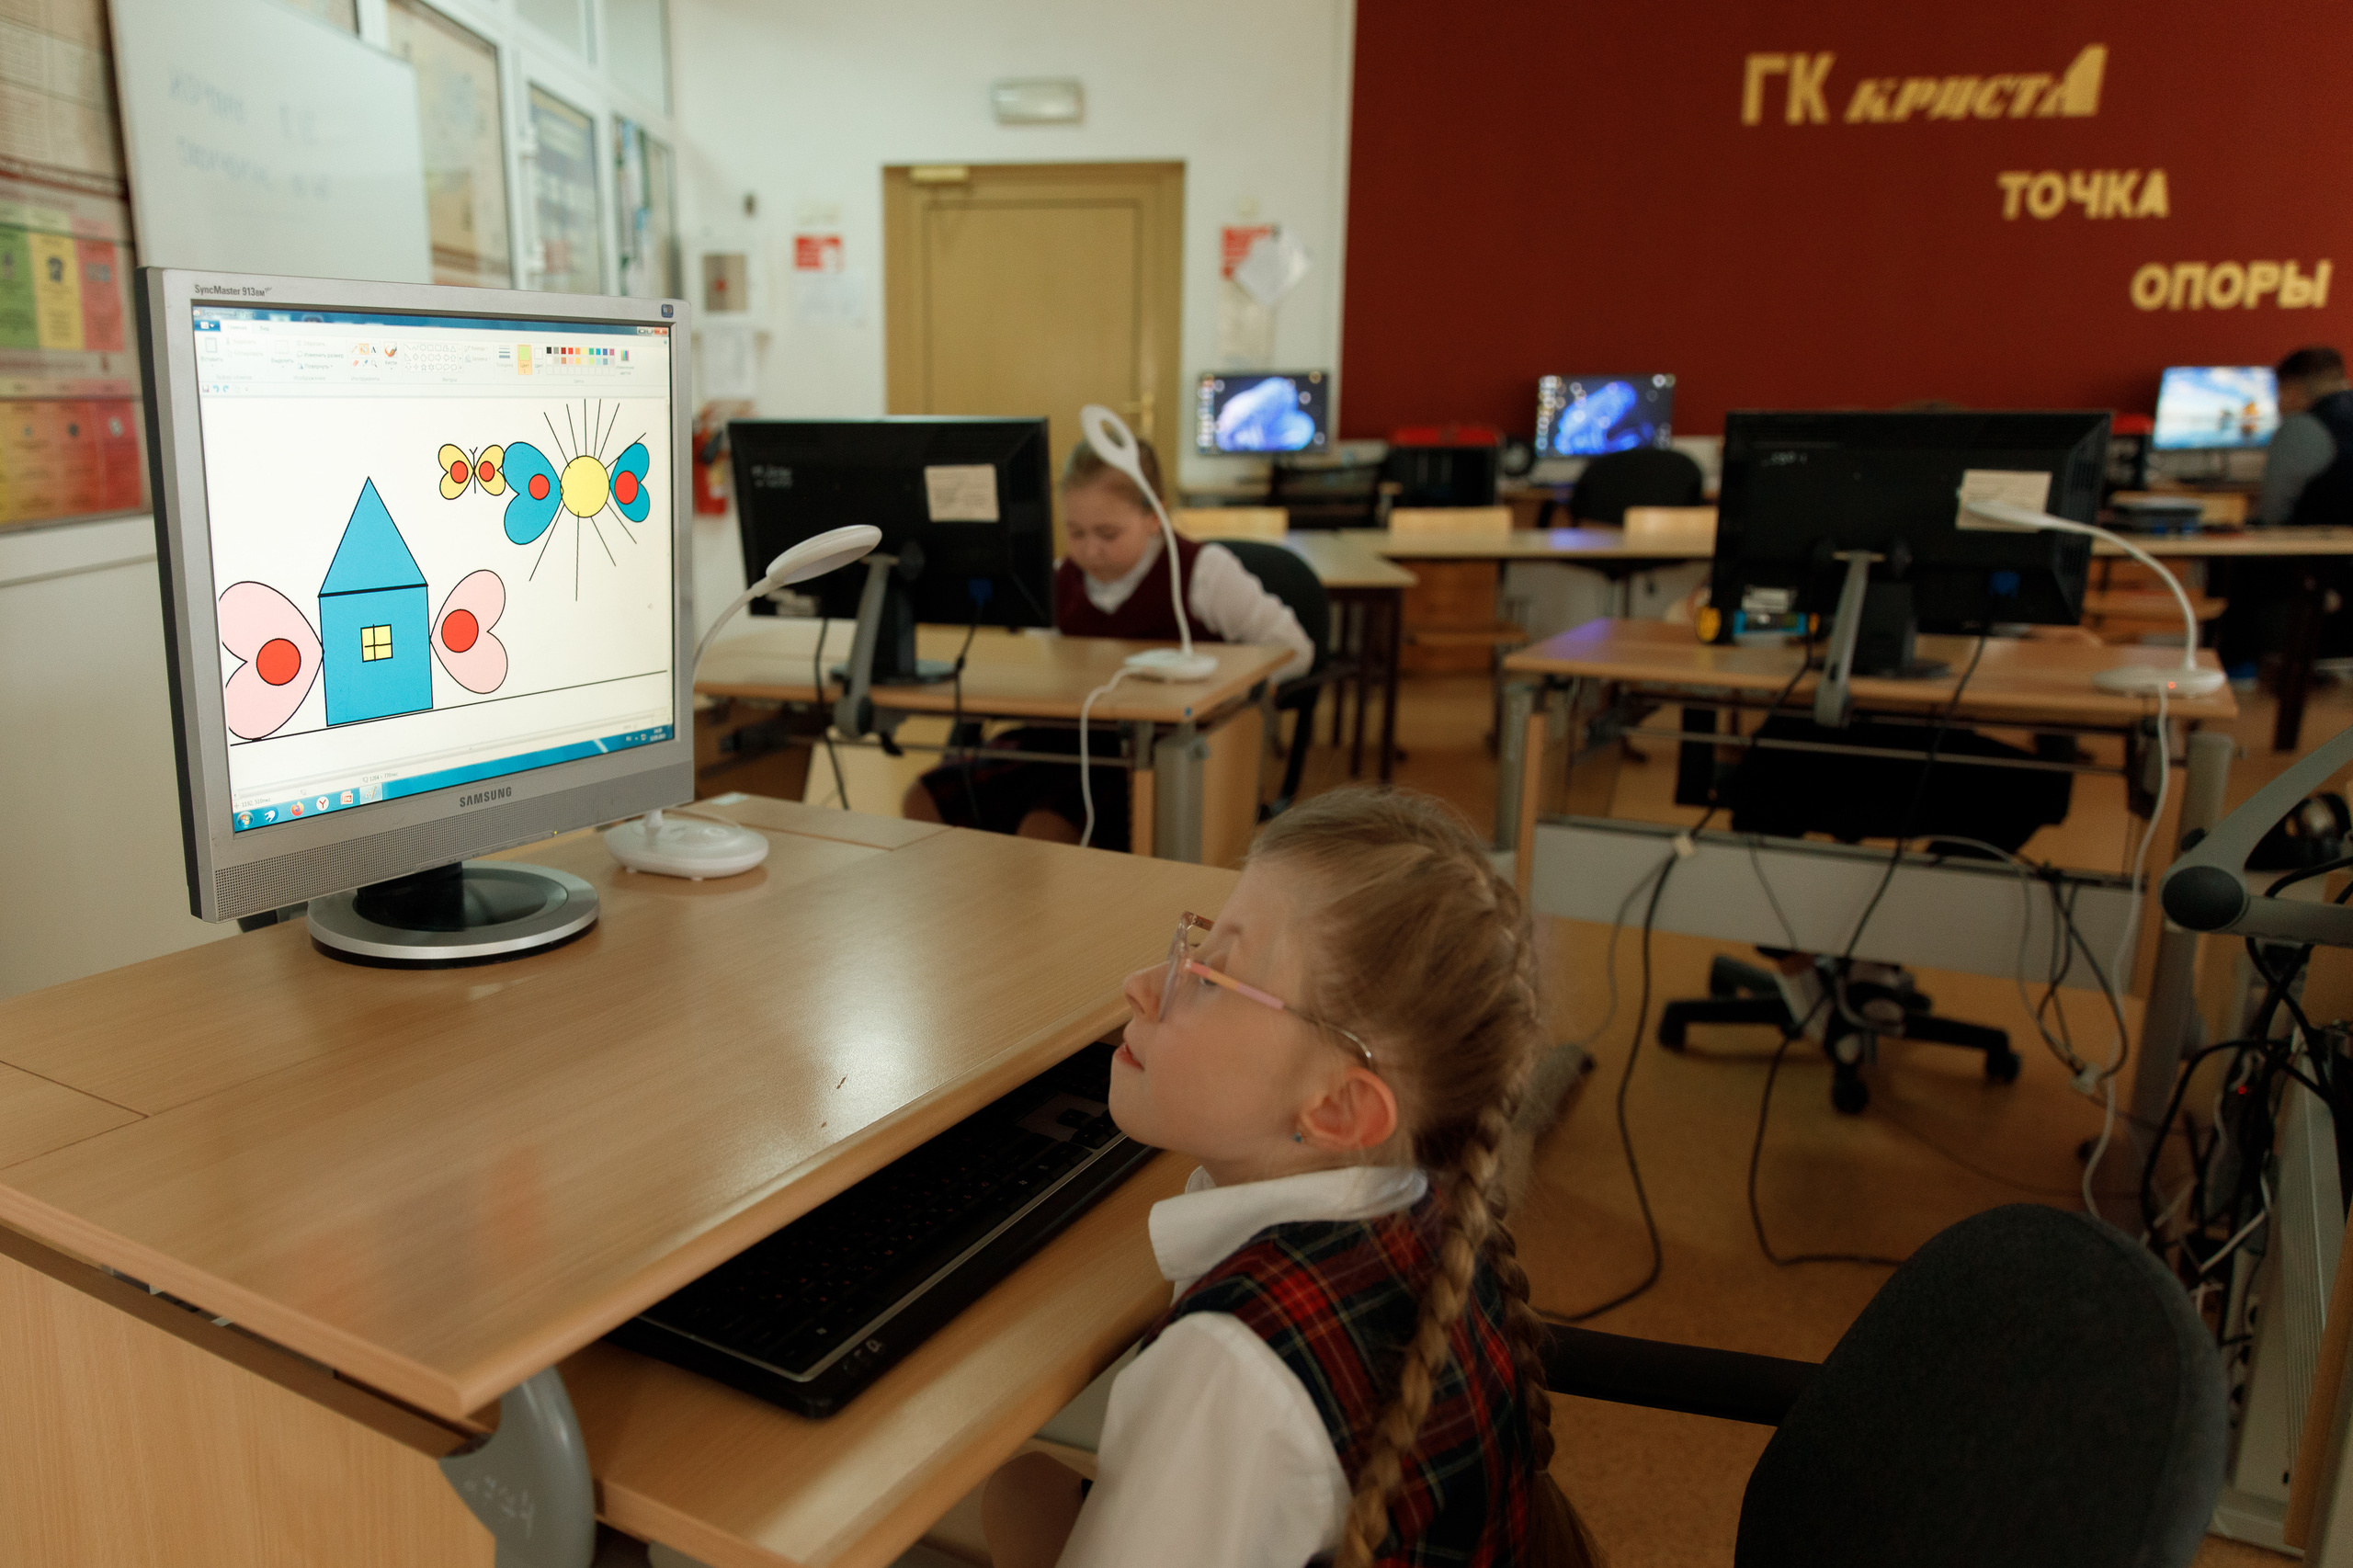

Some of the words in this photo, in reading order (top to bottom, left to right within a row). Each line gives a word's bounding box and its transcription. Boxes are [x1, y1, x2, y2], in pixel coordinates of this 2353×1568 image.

[1743, 51, 1835, 125] ГК
[1997, 169, 2168, 220] ТОЧКА
[194, 284, 241, 295] SyncMaster
[2131, 259, 2332, 311] ОПОРЫ
[460, 787, 512, 807] SAMSUNG
